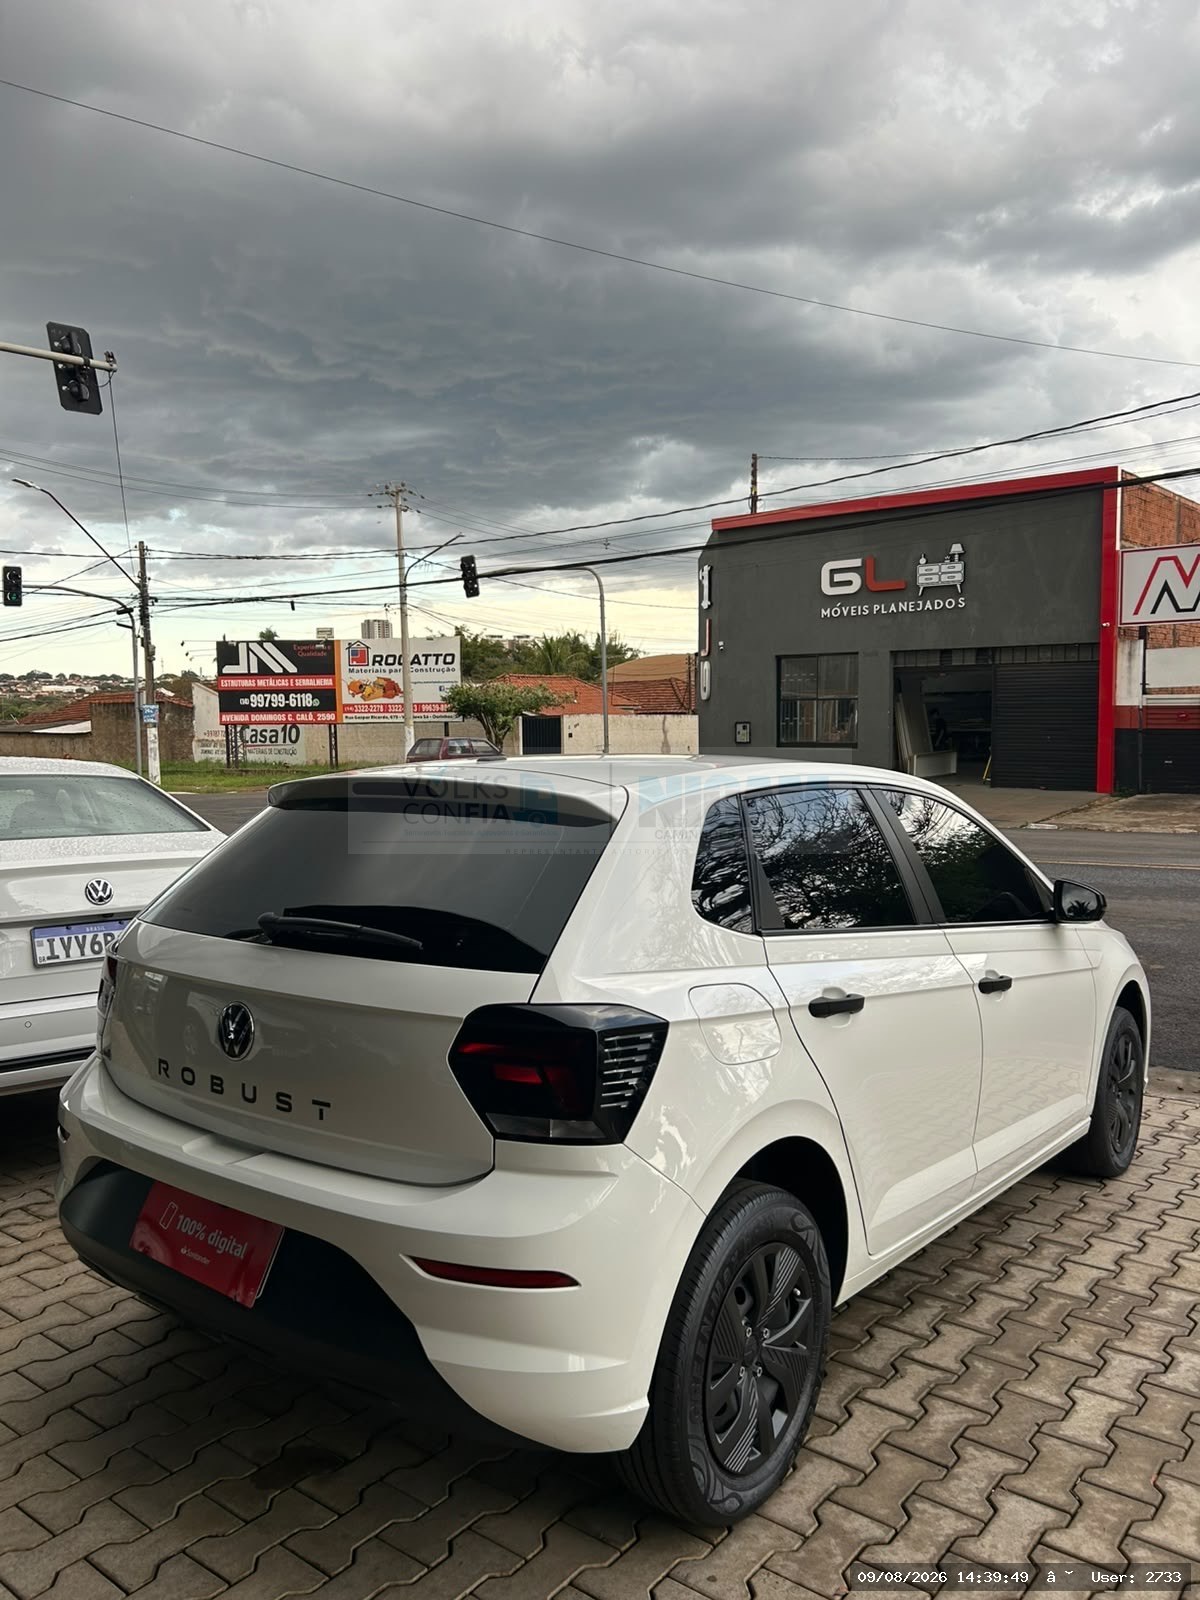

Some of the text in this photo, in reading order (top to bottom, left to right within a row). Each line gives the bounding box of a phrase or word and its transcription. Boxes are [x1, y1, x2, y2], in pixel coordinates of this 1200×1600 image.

[820, 555, 907, 596] GL
[821, 597, 966, 619] MÓVEIS PLANEJADOS
[221, 679, 256, 688] ESTRUTURAS
[257, 677, 289, 687] METÁLICAS
[295, 678, 333, 687] SERRALHERIA
[250, 693, 313, 708] 99799-6118
[222, 714, 249, 722] AVENIDA
[251, 713, 286, 721] DOMINGOS
[317, 713, 335, 721] 2590
[158, 1058, 331, 1121] ROBUST
[176, 1214, 248, 1260] 100% digital
